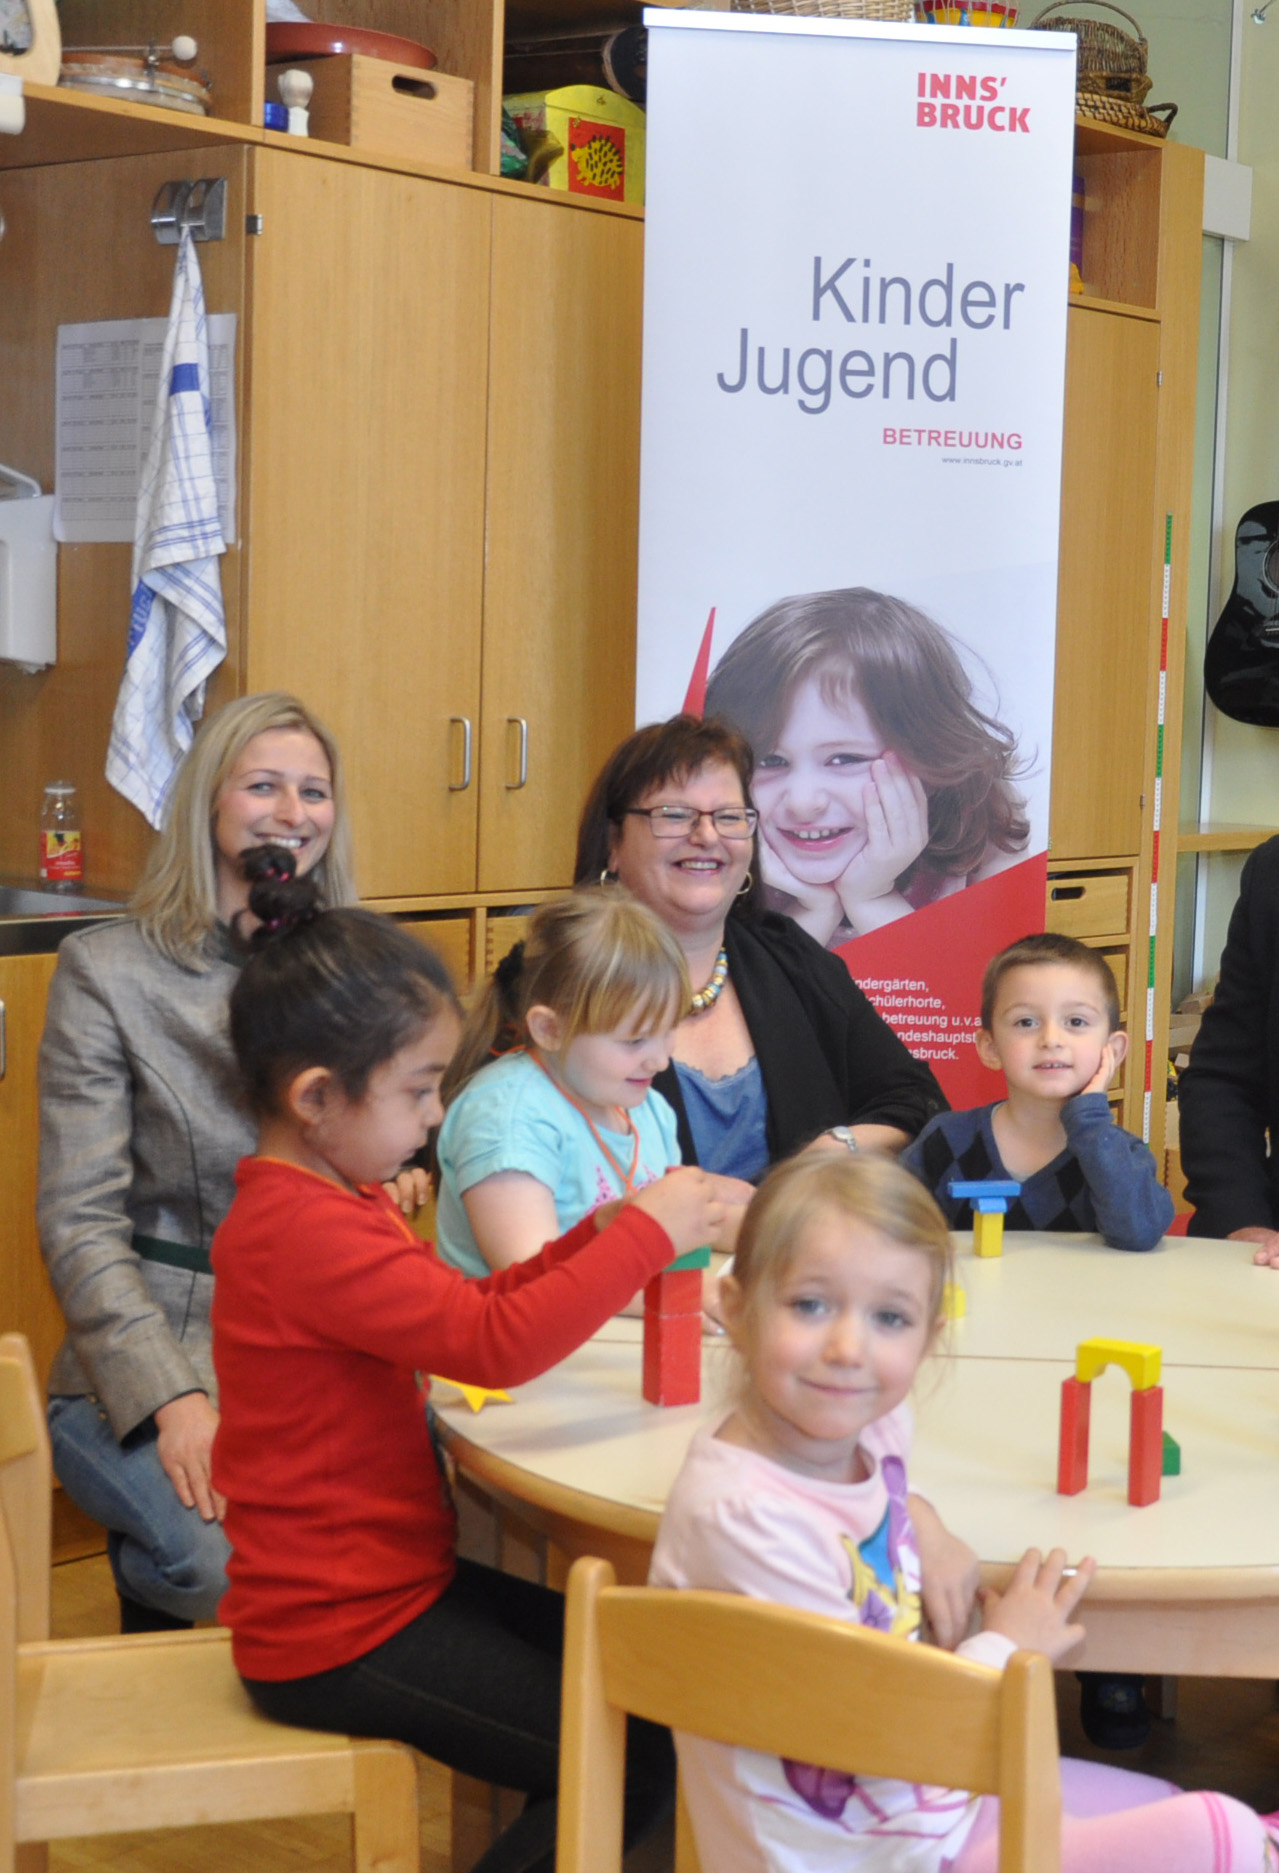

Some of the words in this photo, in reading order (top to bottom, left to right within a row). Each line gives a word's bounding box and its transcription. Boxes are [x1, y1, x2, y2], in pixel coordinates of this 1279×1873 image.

[917, 72, 1008, 102] INNS'
[916, 101, 1031, 133] BRUCK
[812, 256, 1026, 330] Kinder
[716, 327, 958, 415] Jugend
[882, 427, 1023, 450] BETREUUNG
[941, 456, 1023, 467] www.innsbruck.gv.at
[853, 978, 930, 993] ndergärten,
[867, 995, 946, 1010] chülerhorte,
[881, 1012, 948, 1028] betreuung
[951, 1016, 982, 1026] u.v.a
[896, 1030, 978, 1045] ndeshauptst
[908, 1047, 960, 1060] sbruck.
